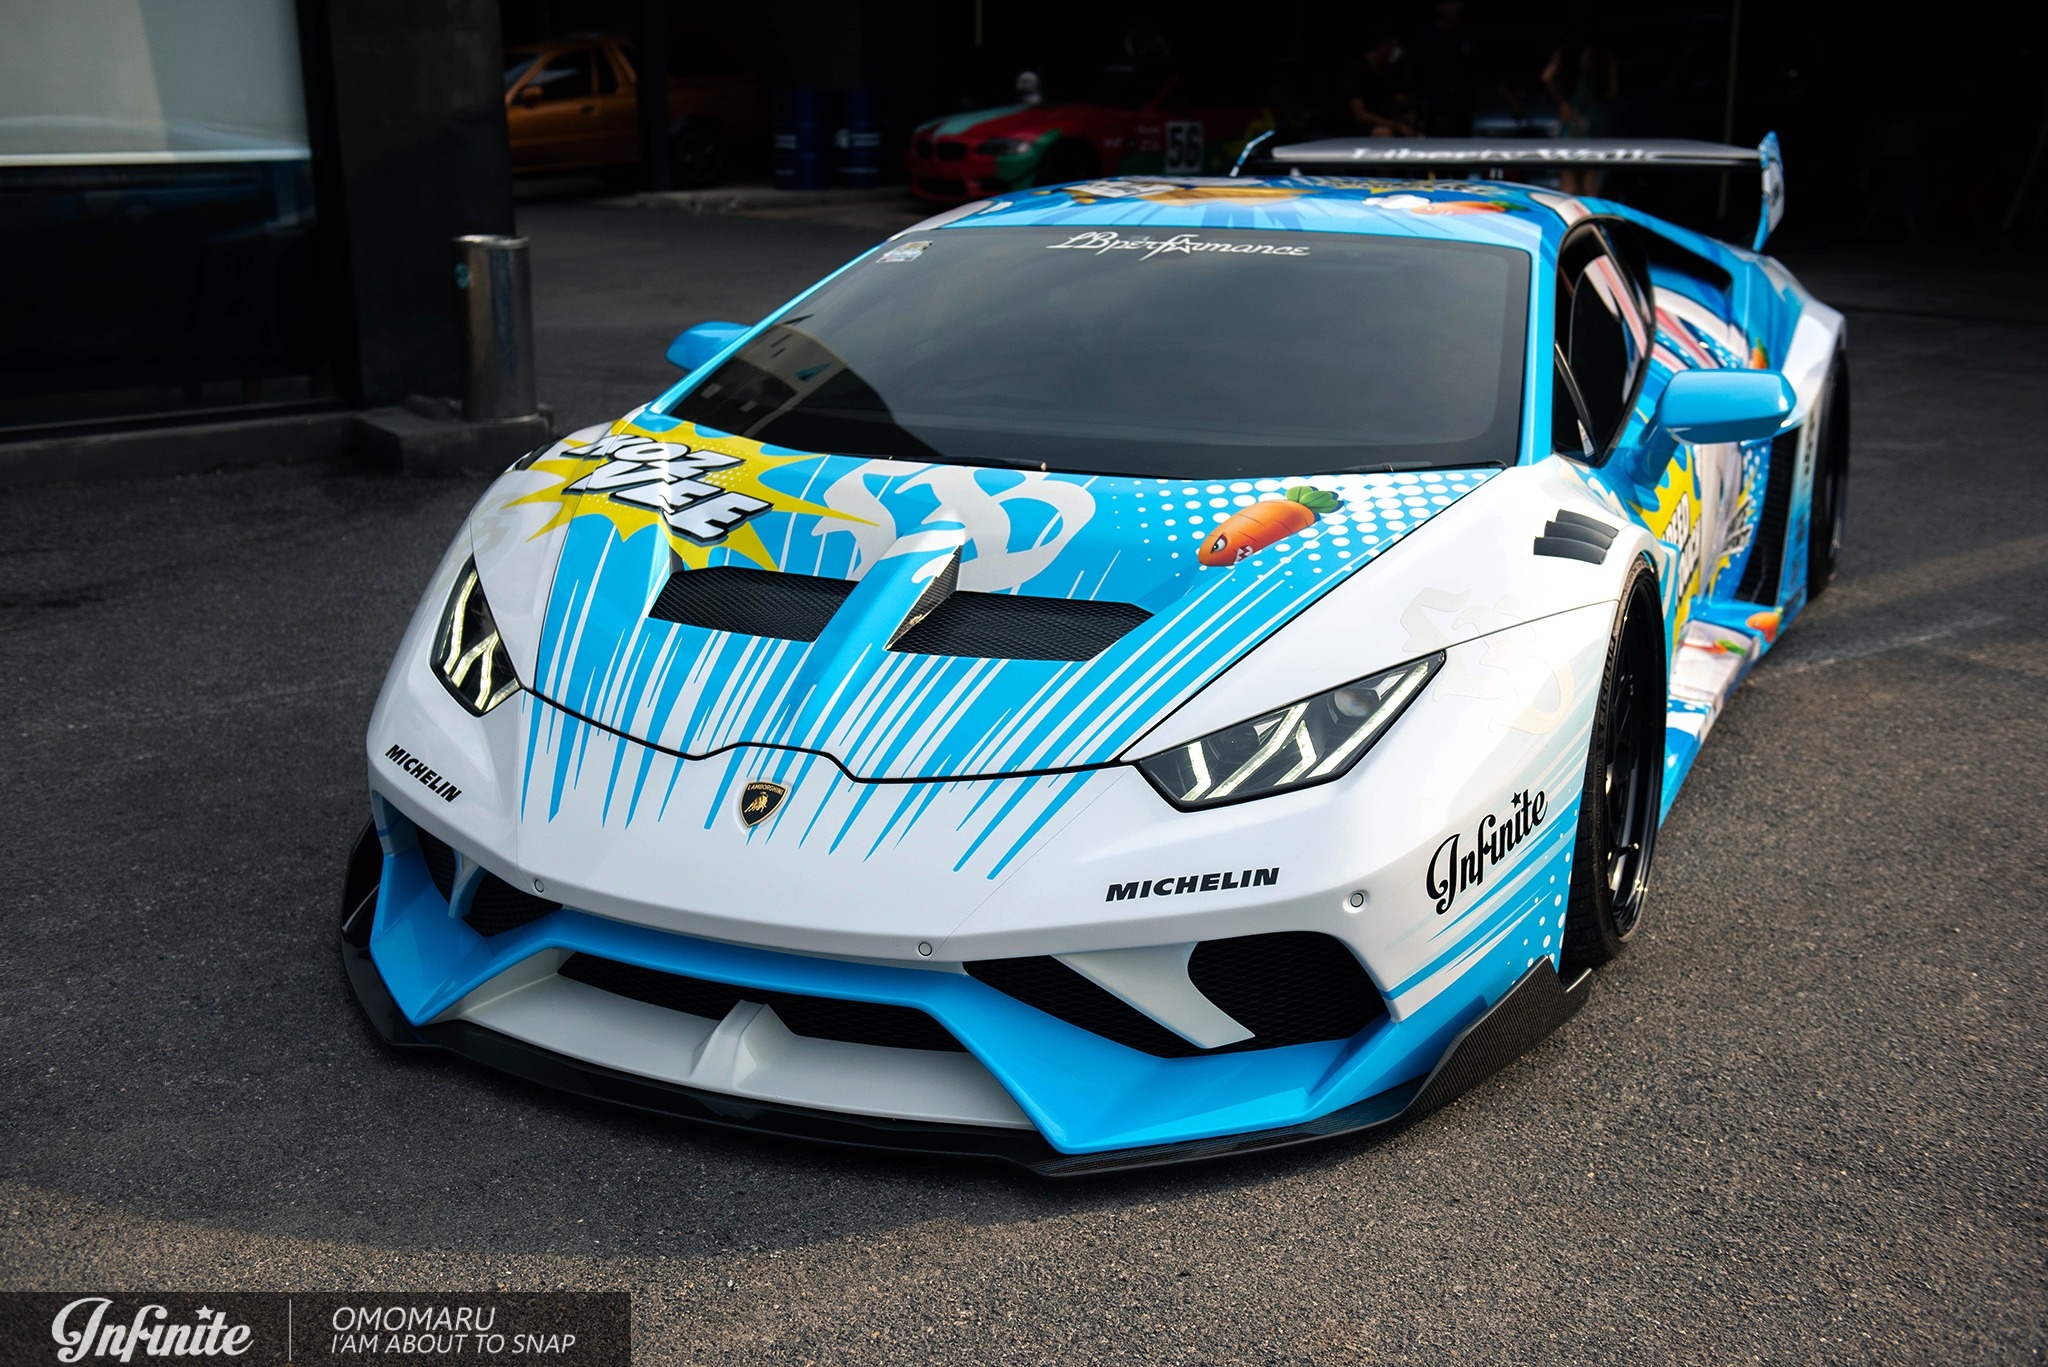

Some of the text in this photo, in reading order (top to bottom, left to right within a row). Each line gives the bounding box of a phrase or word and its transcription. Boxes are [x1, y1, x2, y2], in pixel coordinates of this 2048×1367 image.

[1169, 126, 1200, 168] 56
[385, 744, 462, 803] MICHELIN
[1426, 789, 1549, 915] Infinite
[1105, 867, 1280, 902] MICHELIN
